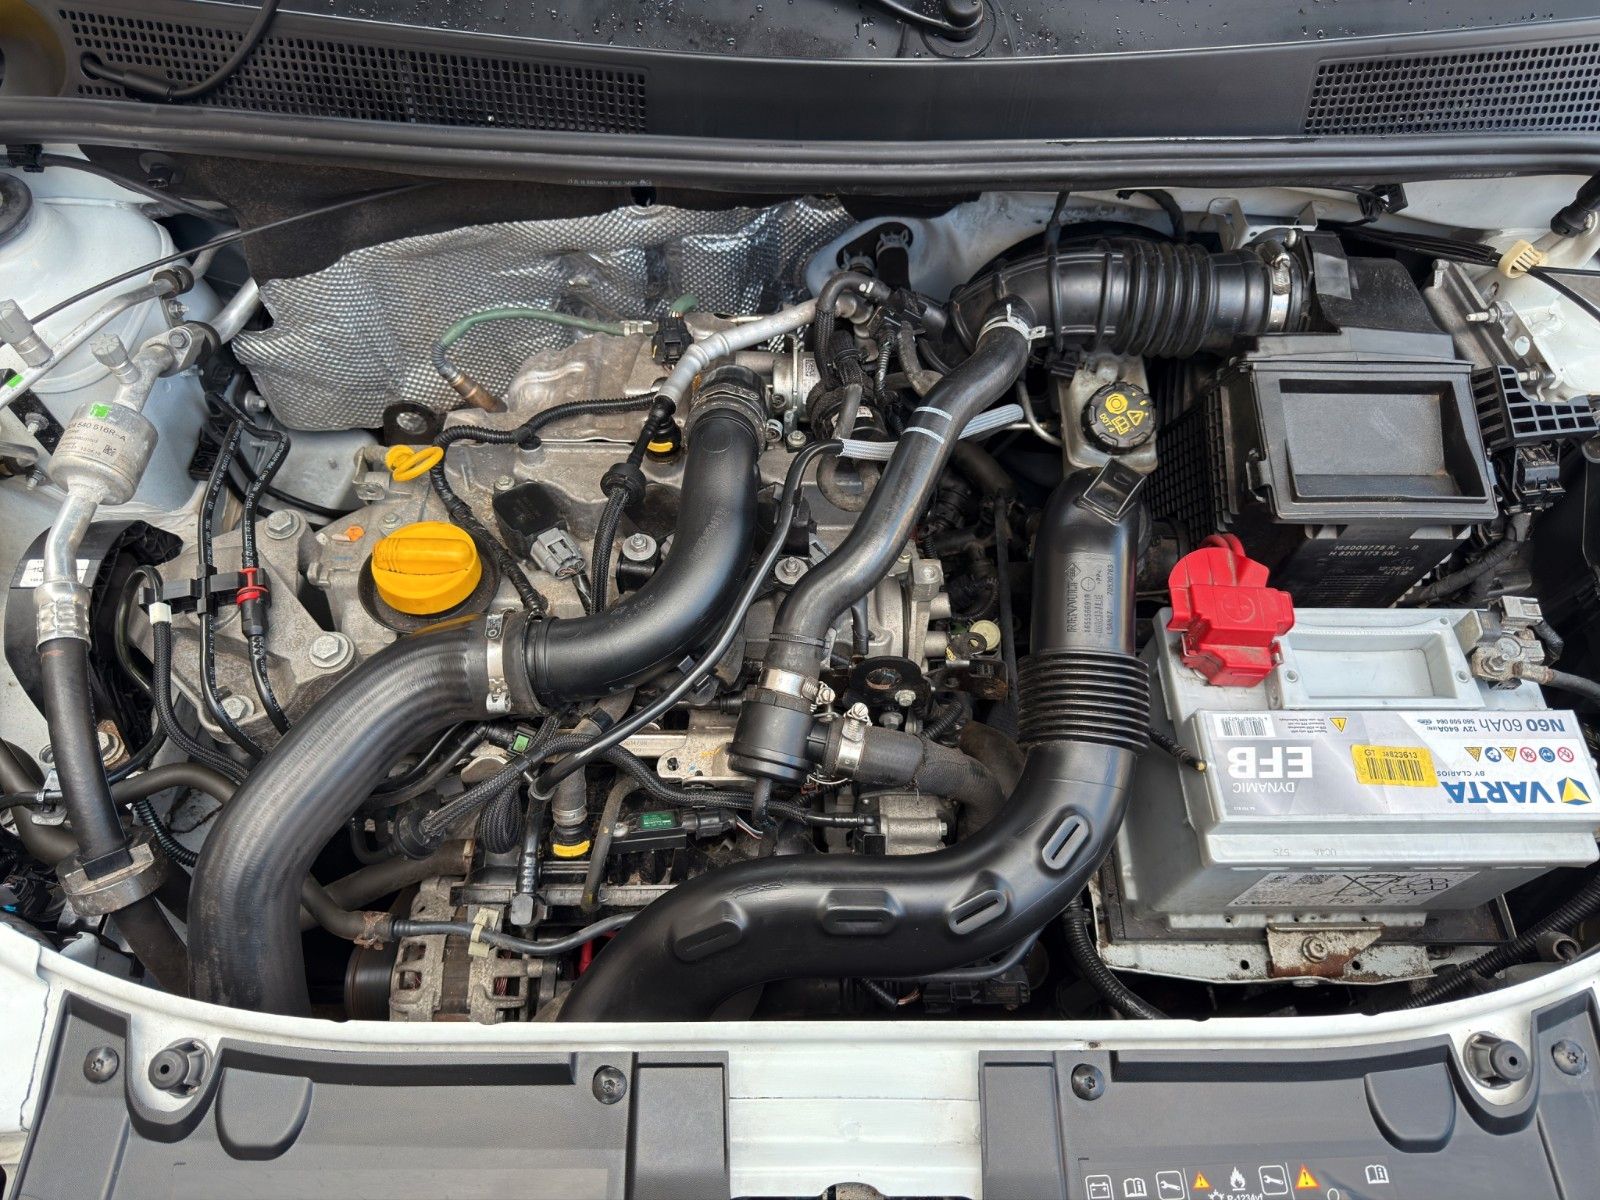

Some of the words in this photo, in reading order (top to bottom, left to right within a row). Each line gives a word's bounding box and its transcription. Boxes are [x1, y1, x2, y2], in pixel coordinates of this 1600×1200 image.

[1099, 412, 1112, 427] DOT
[1066, 582, 1078, 633] RENAULT
[1478, 718, 1523, 733] 60Ah
[1526, 718, 1566, 733] N60
[1364, 748, 1376, 756] GT
[1227, 746, 1313, 779] EFB
[1232, 781, 1295, 794] DYNAMIC
[1440, 781, 1555, 804] VARTA
